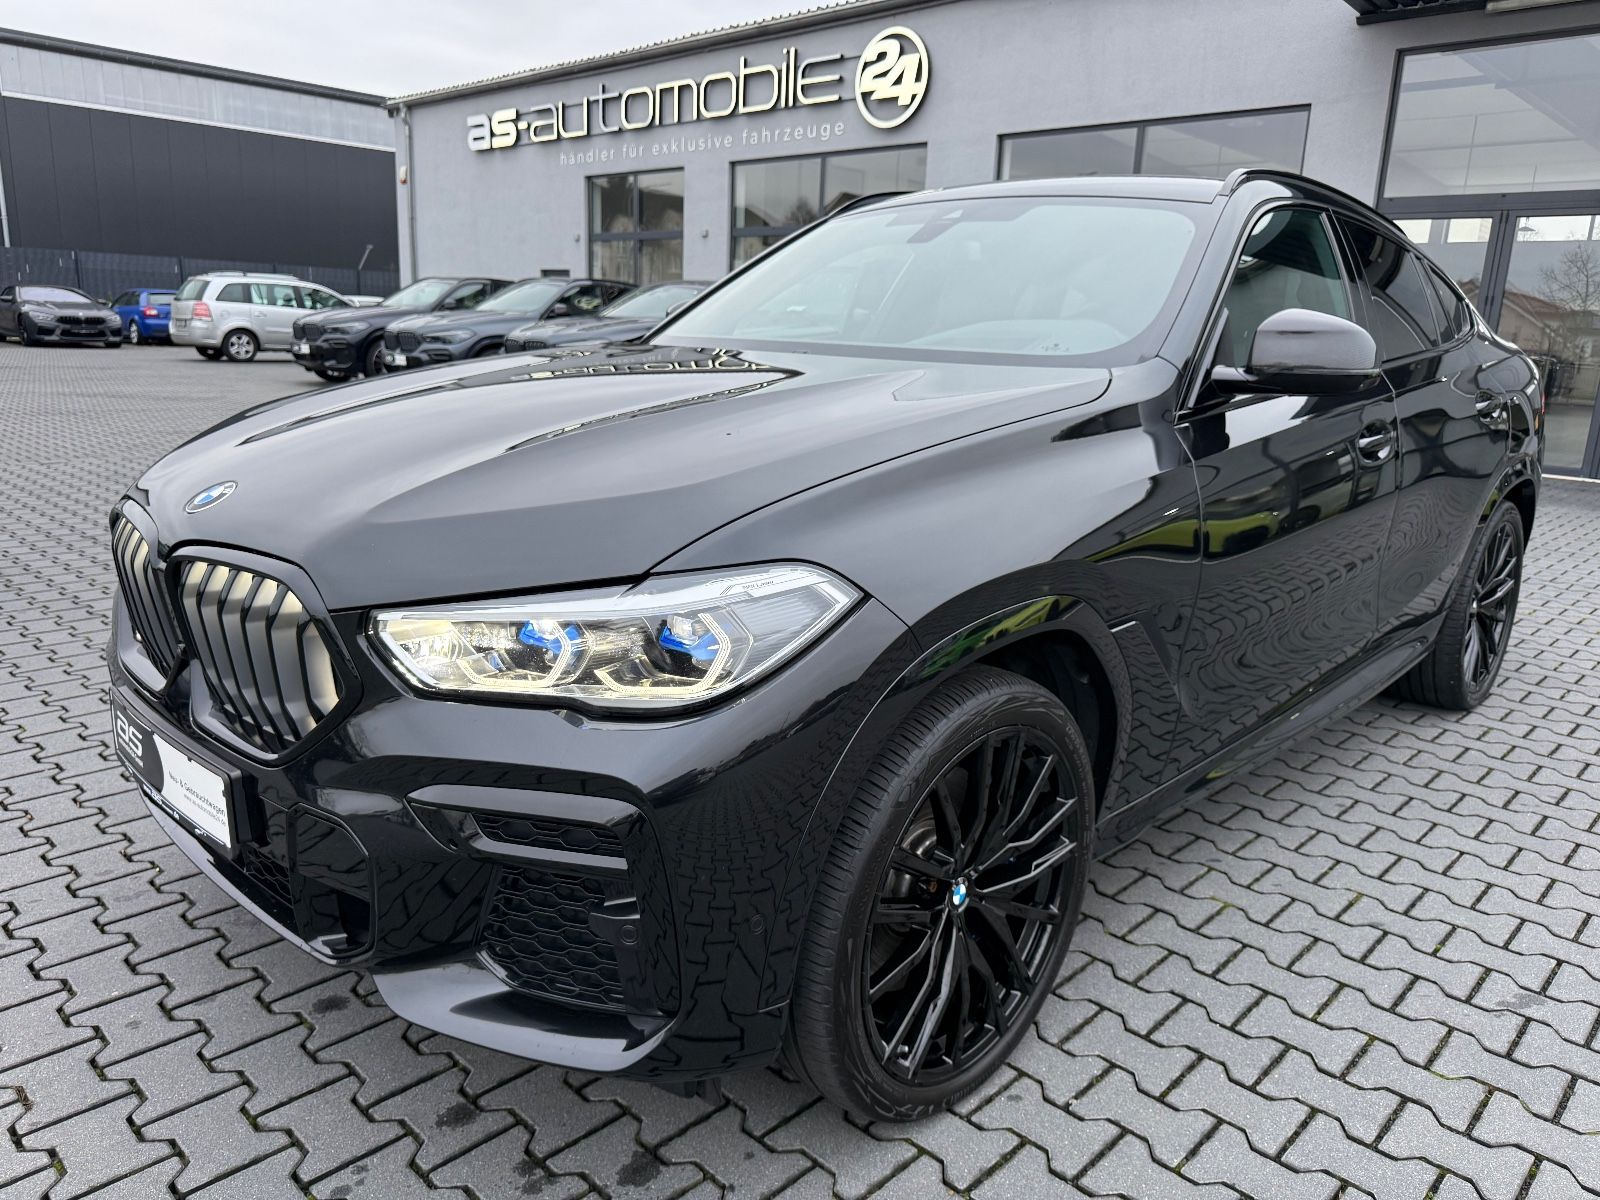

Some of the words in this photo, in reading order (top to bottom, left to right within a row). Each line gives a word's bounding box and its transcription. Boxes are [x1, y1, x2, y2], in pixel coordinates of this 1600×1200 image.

[860, 37, 922, 107] 24
[560, 147, 615, 165] händler
[622, 143, 643, 159] für
[652, 133, 733, 156] exklusive
[742, 121, 845, 145] fahrzeuge
